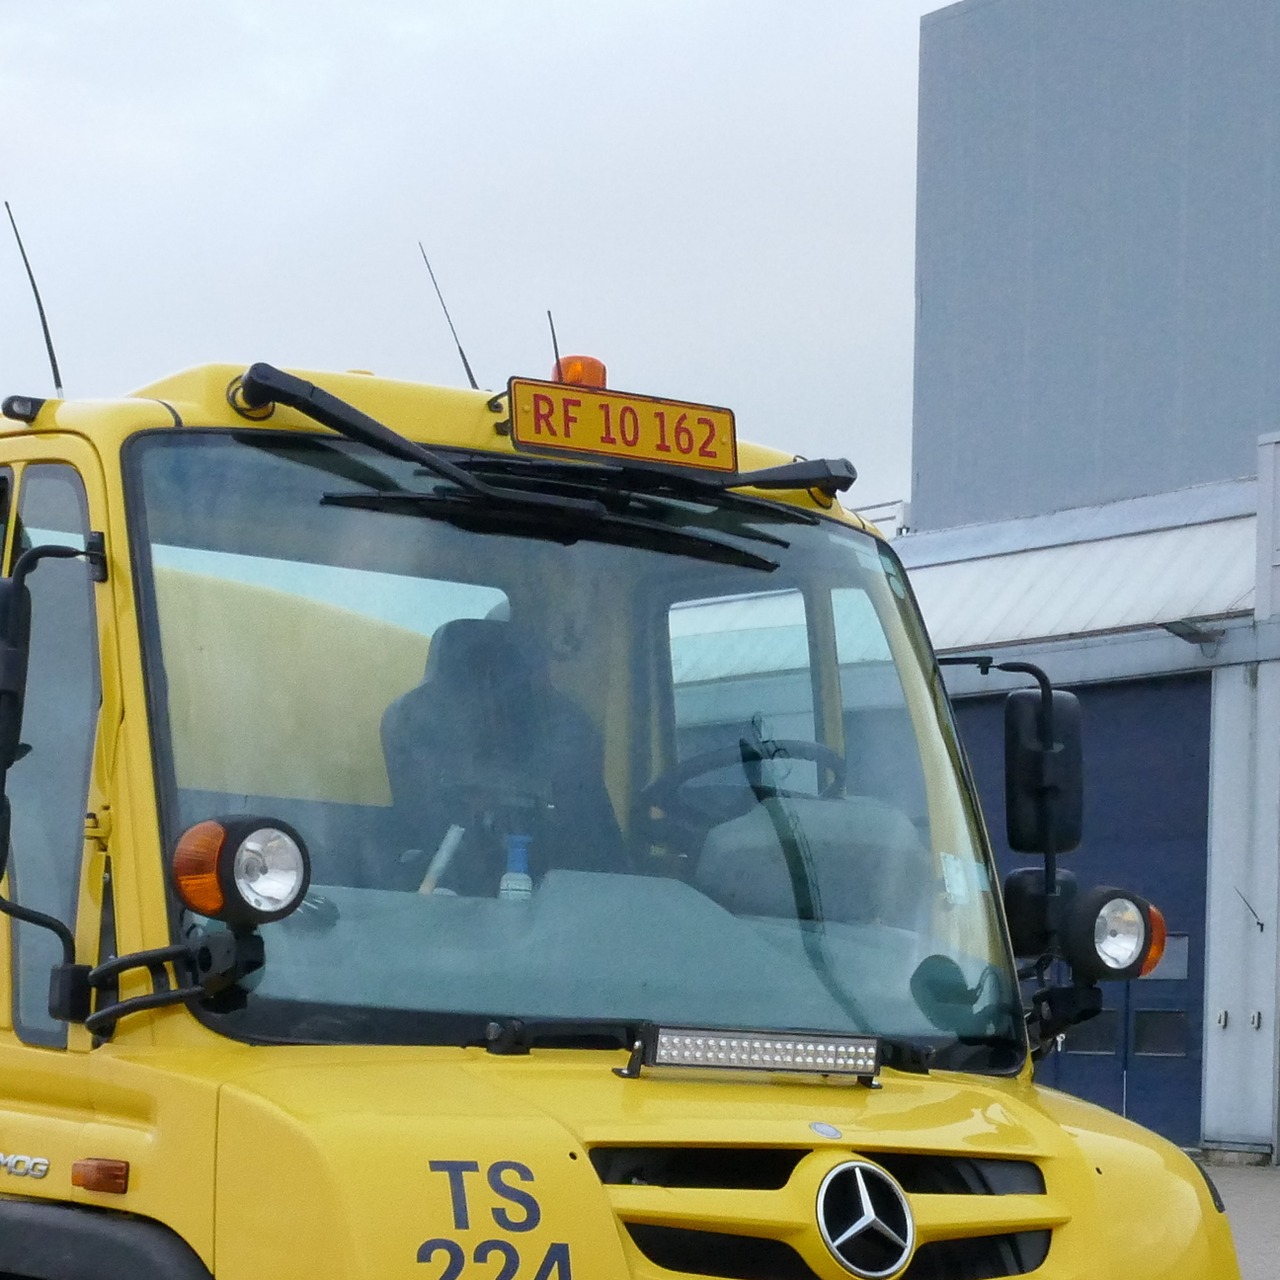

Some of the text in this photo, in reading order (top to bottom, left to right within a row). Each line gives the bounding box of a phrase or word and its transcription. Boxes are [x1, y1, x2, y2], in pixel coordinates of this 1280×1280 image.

[533, 393, 718, 459] RF 10 162
[428, 1160, 541, 1233] TS
